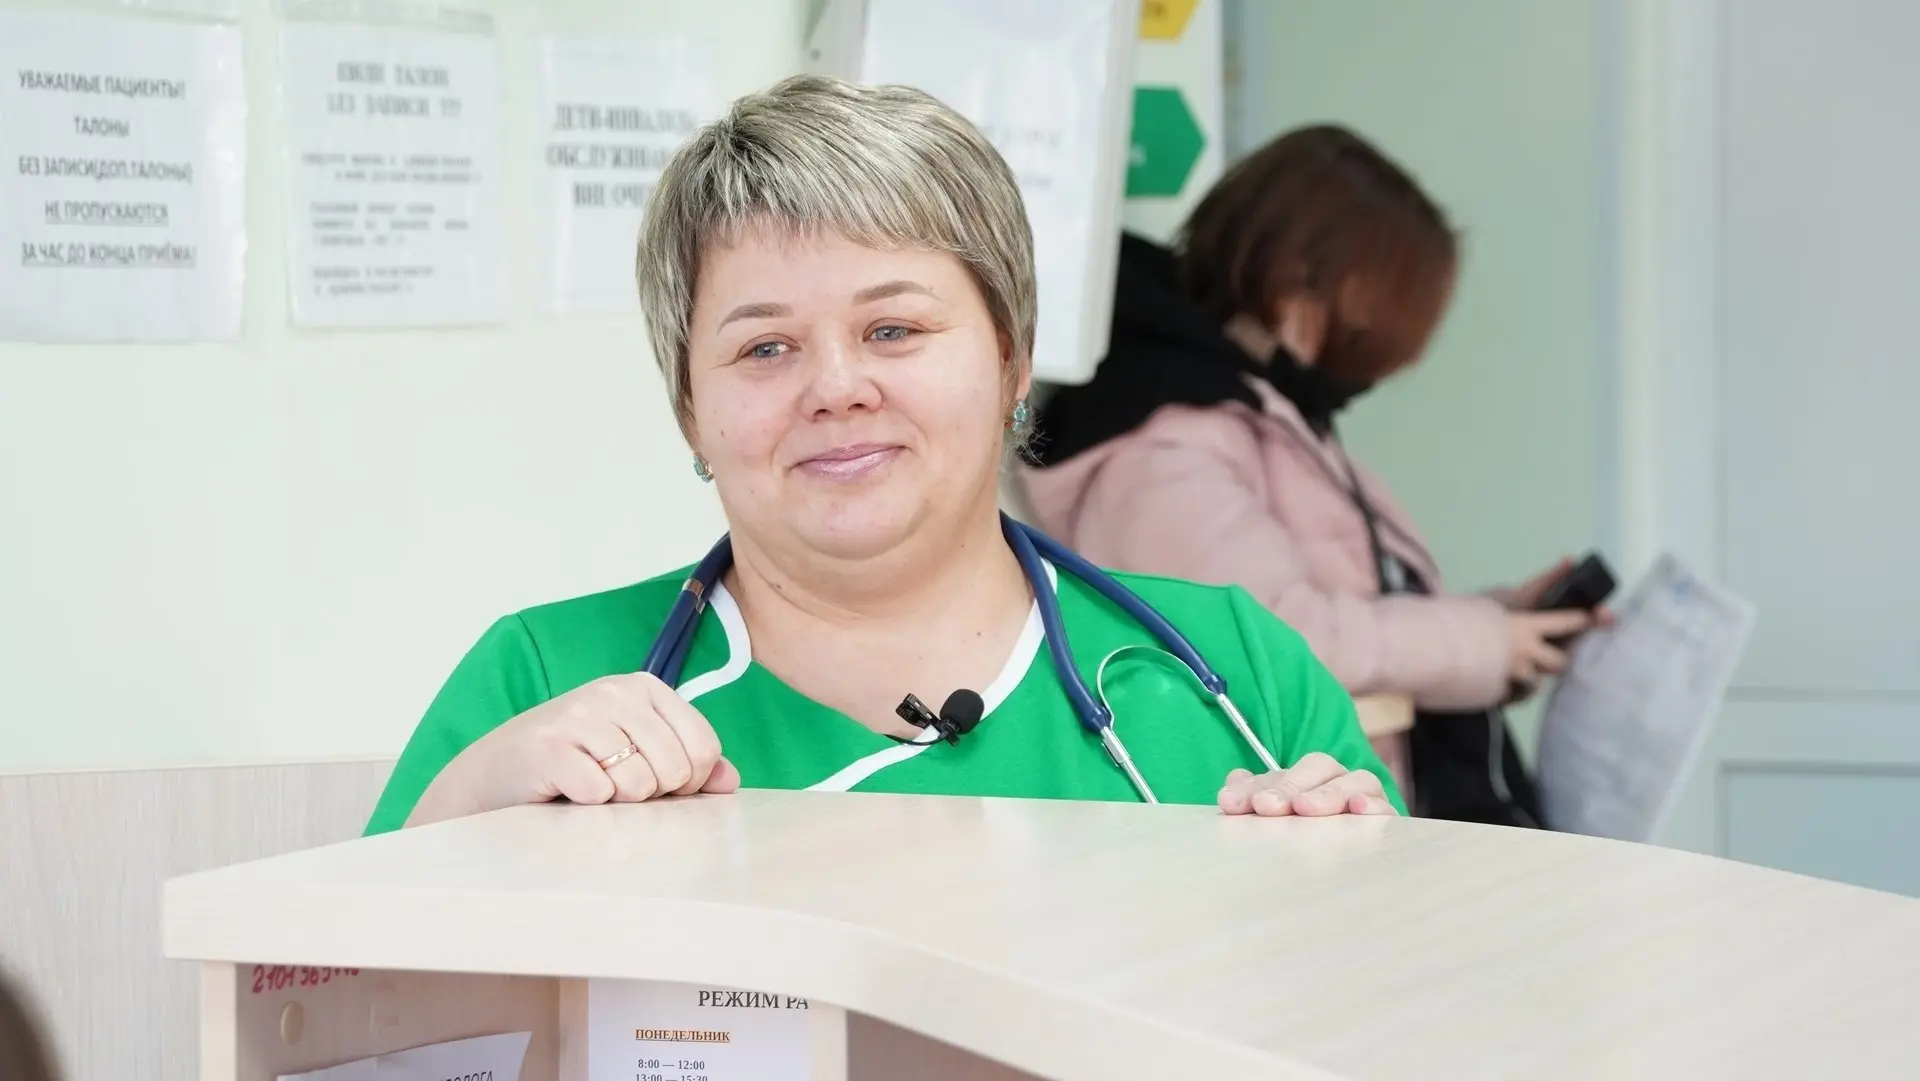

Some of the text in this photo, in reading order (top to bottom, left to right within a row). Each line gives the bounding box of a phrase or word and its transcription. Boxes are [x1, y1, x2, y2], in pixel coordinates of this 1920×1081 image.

[18, 68, 186, 100] УВАЖАЕМЫЕ ПАЦИЕНТЫ!
[74, 115, 130, 137] ТАЛОНЫ
[19, 155, 40, 176] БЕЗ
[45, 200, 169, 225] НЕ ПРОПУСКАЮТСЯ
[22, 242, 38, 264] ЗА
[39, 242, 64, 264] ЧАС
[67, 242, 86, 265] ДО
[89, 243, 136, 266] КОНЦА
[697, 990, 781, 1009] РЕЖИМ
[634, 1028, 732, 1043] ПОНЕДЕЛЬНИК
[637, 1058, 660, 1070] 8:00
[677, 1059, 706, 1071] 12:00
